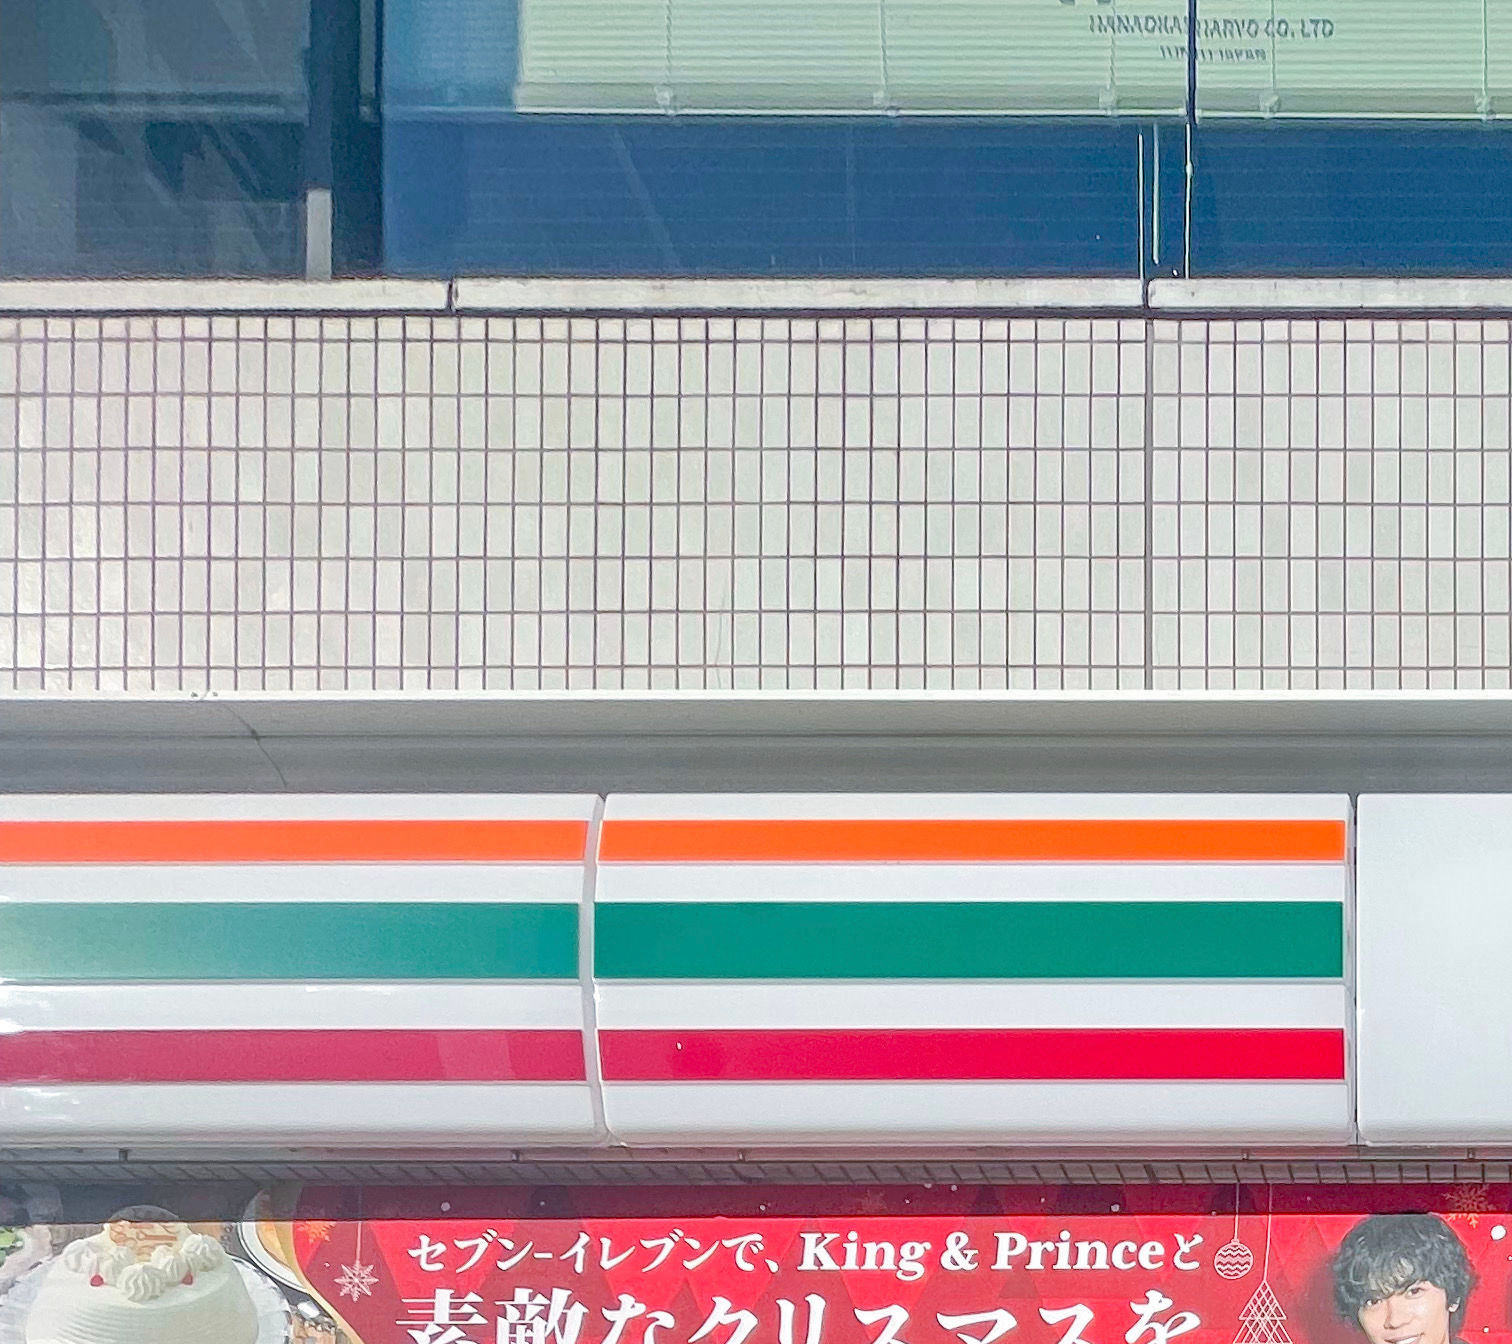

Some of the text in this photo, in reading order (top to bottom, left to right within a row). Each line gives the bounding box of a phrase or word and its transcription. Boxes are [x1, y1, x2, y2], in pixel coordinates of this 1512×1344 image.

[1301, 18, 1335, 39] LTD
[796, 1230, 932, 1282] King
[940, 1231, 980, 1271] &
[990, 1229, 1204, 1272] Princeと
